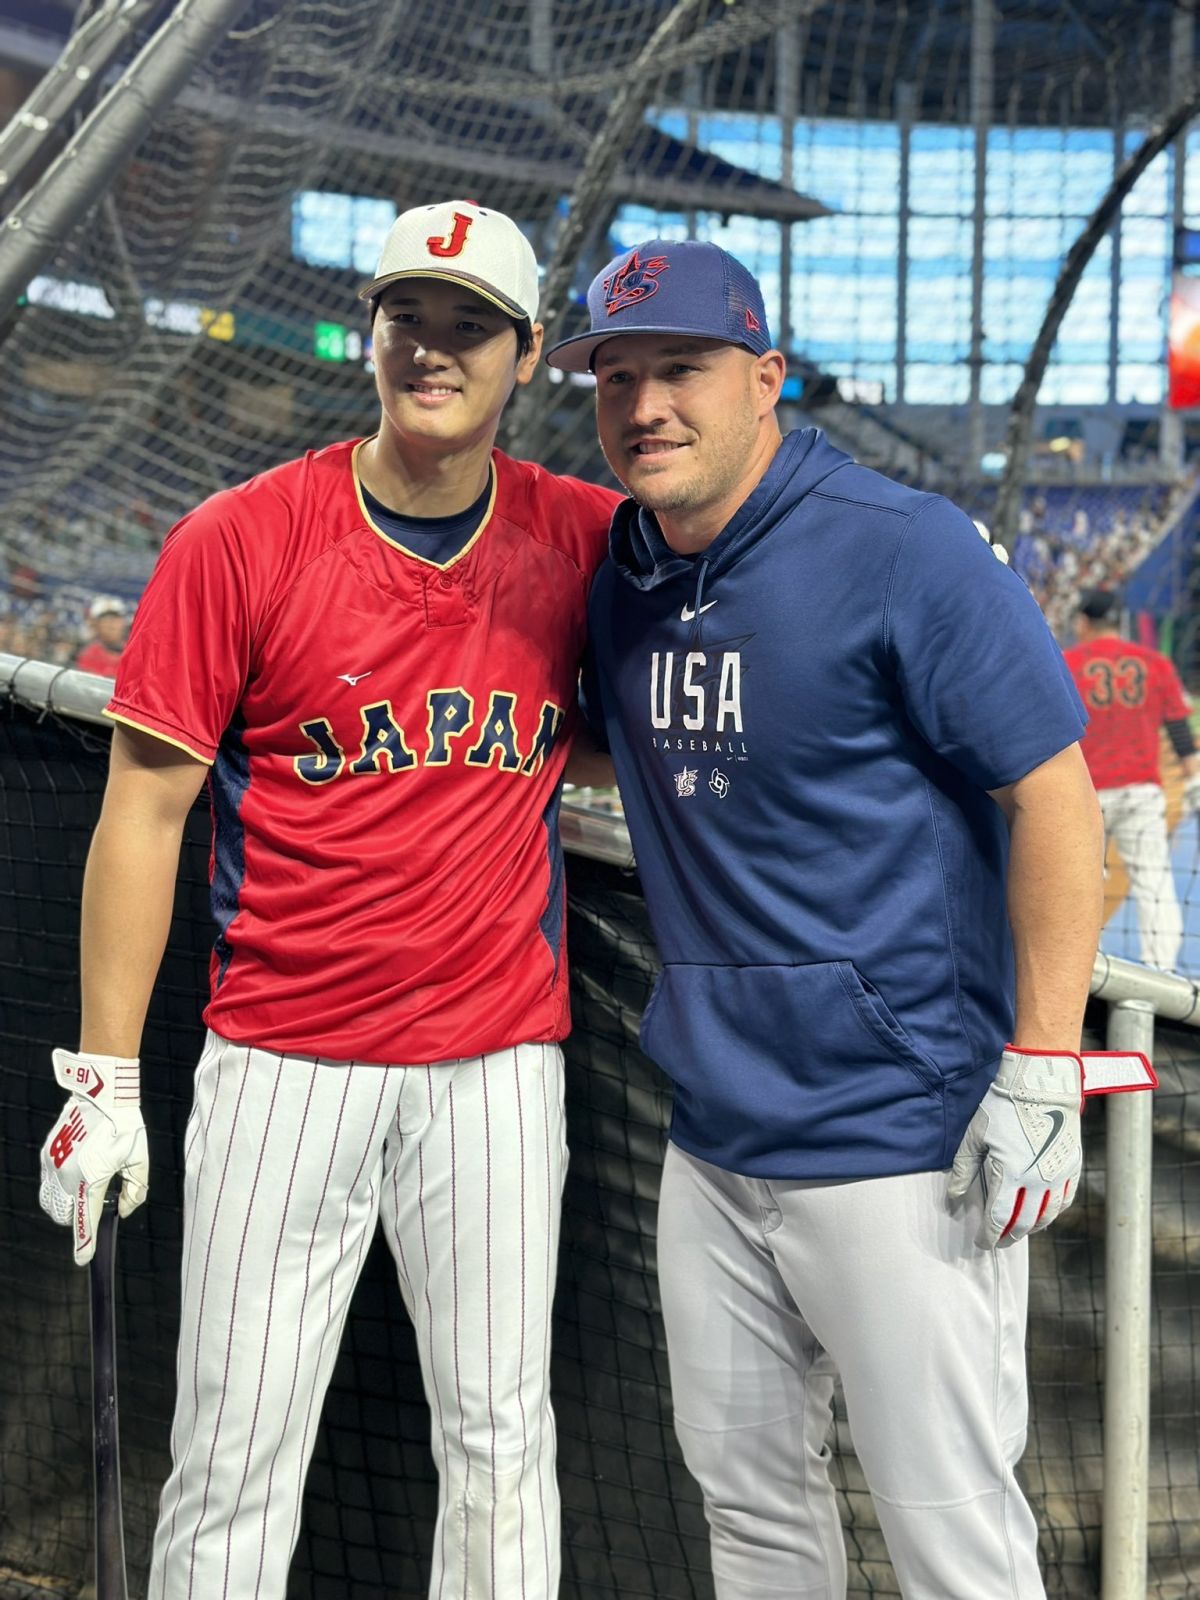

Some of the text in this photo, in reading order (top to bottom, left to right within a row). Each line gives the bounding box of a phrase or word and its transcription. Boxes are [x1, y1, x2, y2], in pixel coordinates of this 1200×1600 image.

[425, 211, 474, 259] J
[651, 652, 743, 733] USA
[1083, 657, 1147, 710] 33
[77, 1180, 87, 1240] new balance
